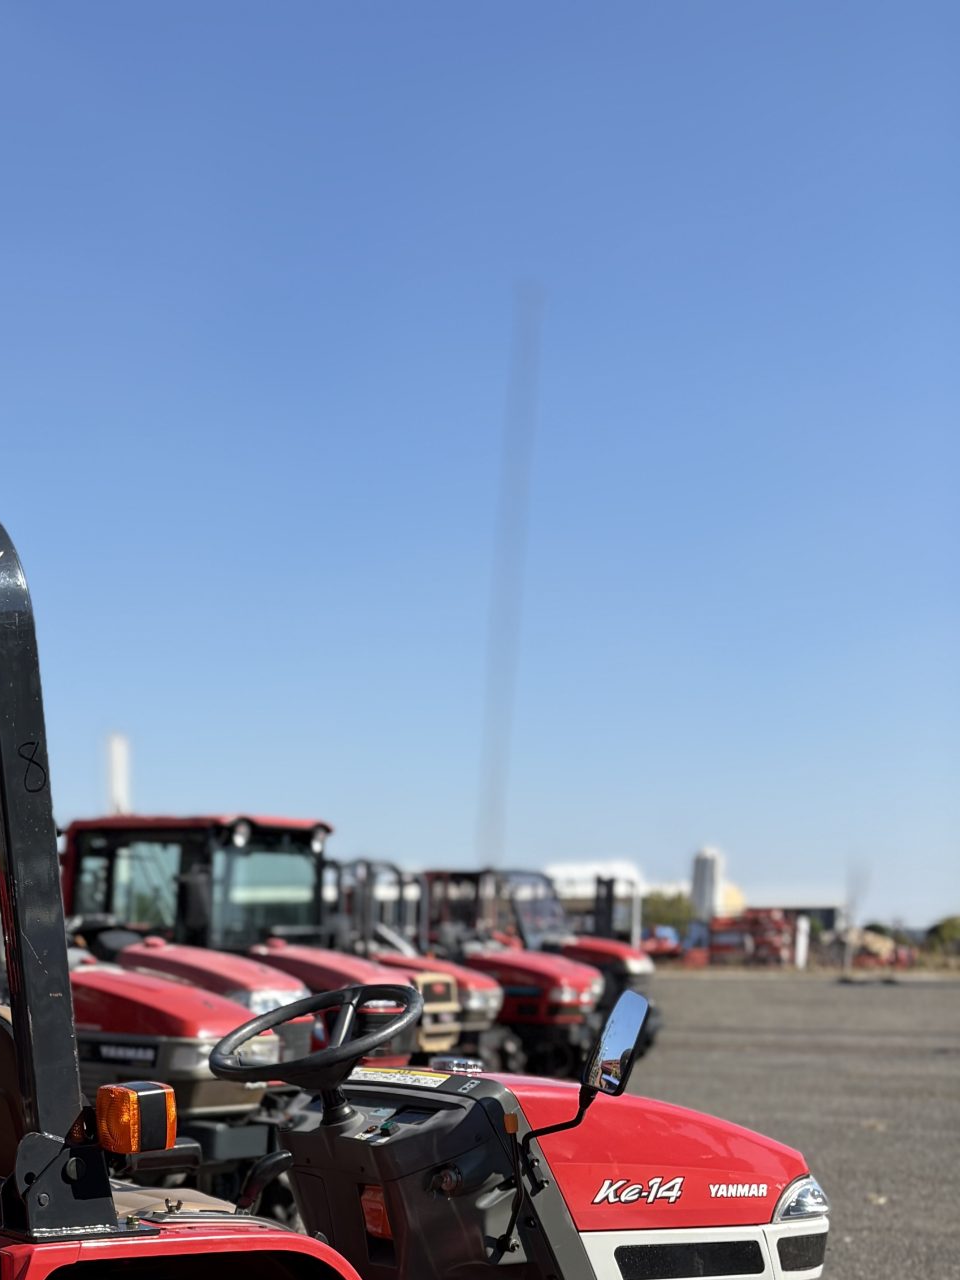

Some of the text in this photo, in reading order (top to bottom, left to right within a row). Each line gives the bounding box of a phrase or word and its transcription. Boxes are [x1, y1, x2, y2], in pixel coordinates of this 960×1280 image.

[17, 740, 47, 793] 8
[591, 1176, 768, 1204] Ke-14 YANMAR
